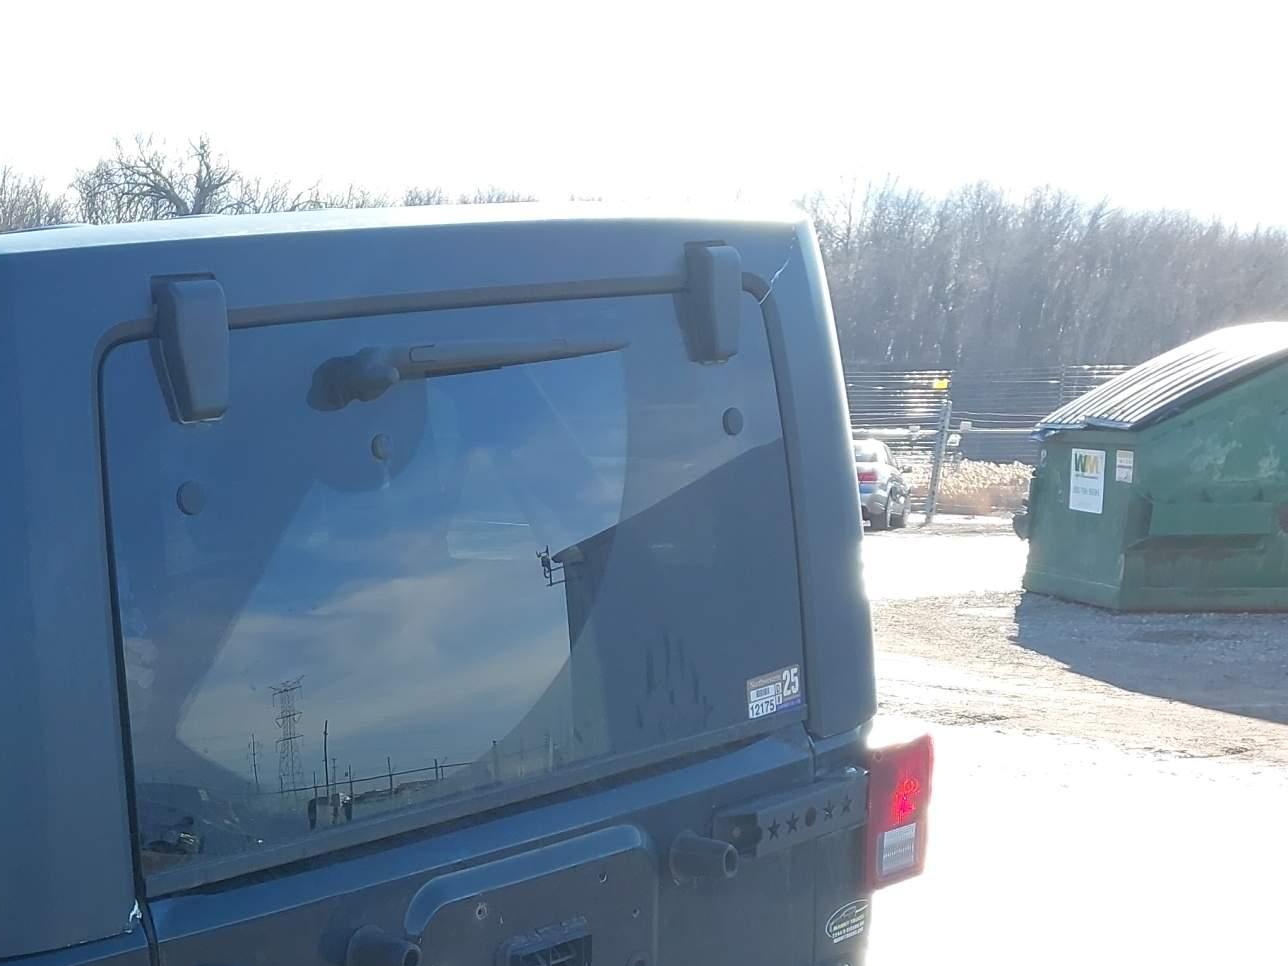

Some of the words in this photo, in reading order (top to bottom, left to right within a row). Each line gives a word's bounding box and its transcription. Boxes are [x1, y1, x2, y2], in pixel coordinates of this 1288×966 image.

[1075, 452, 1101, 474] WM
[782, 667, 799, 696] 25
[750, 699, 775, 717] 12175
